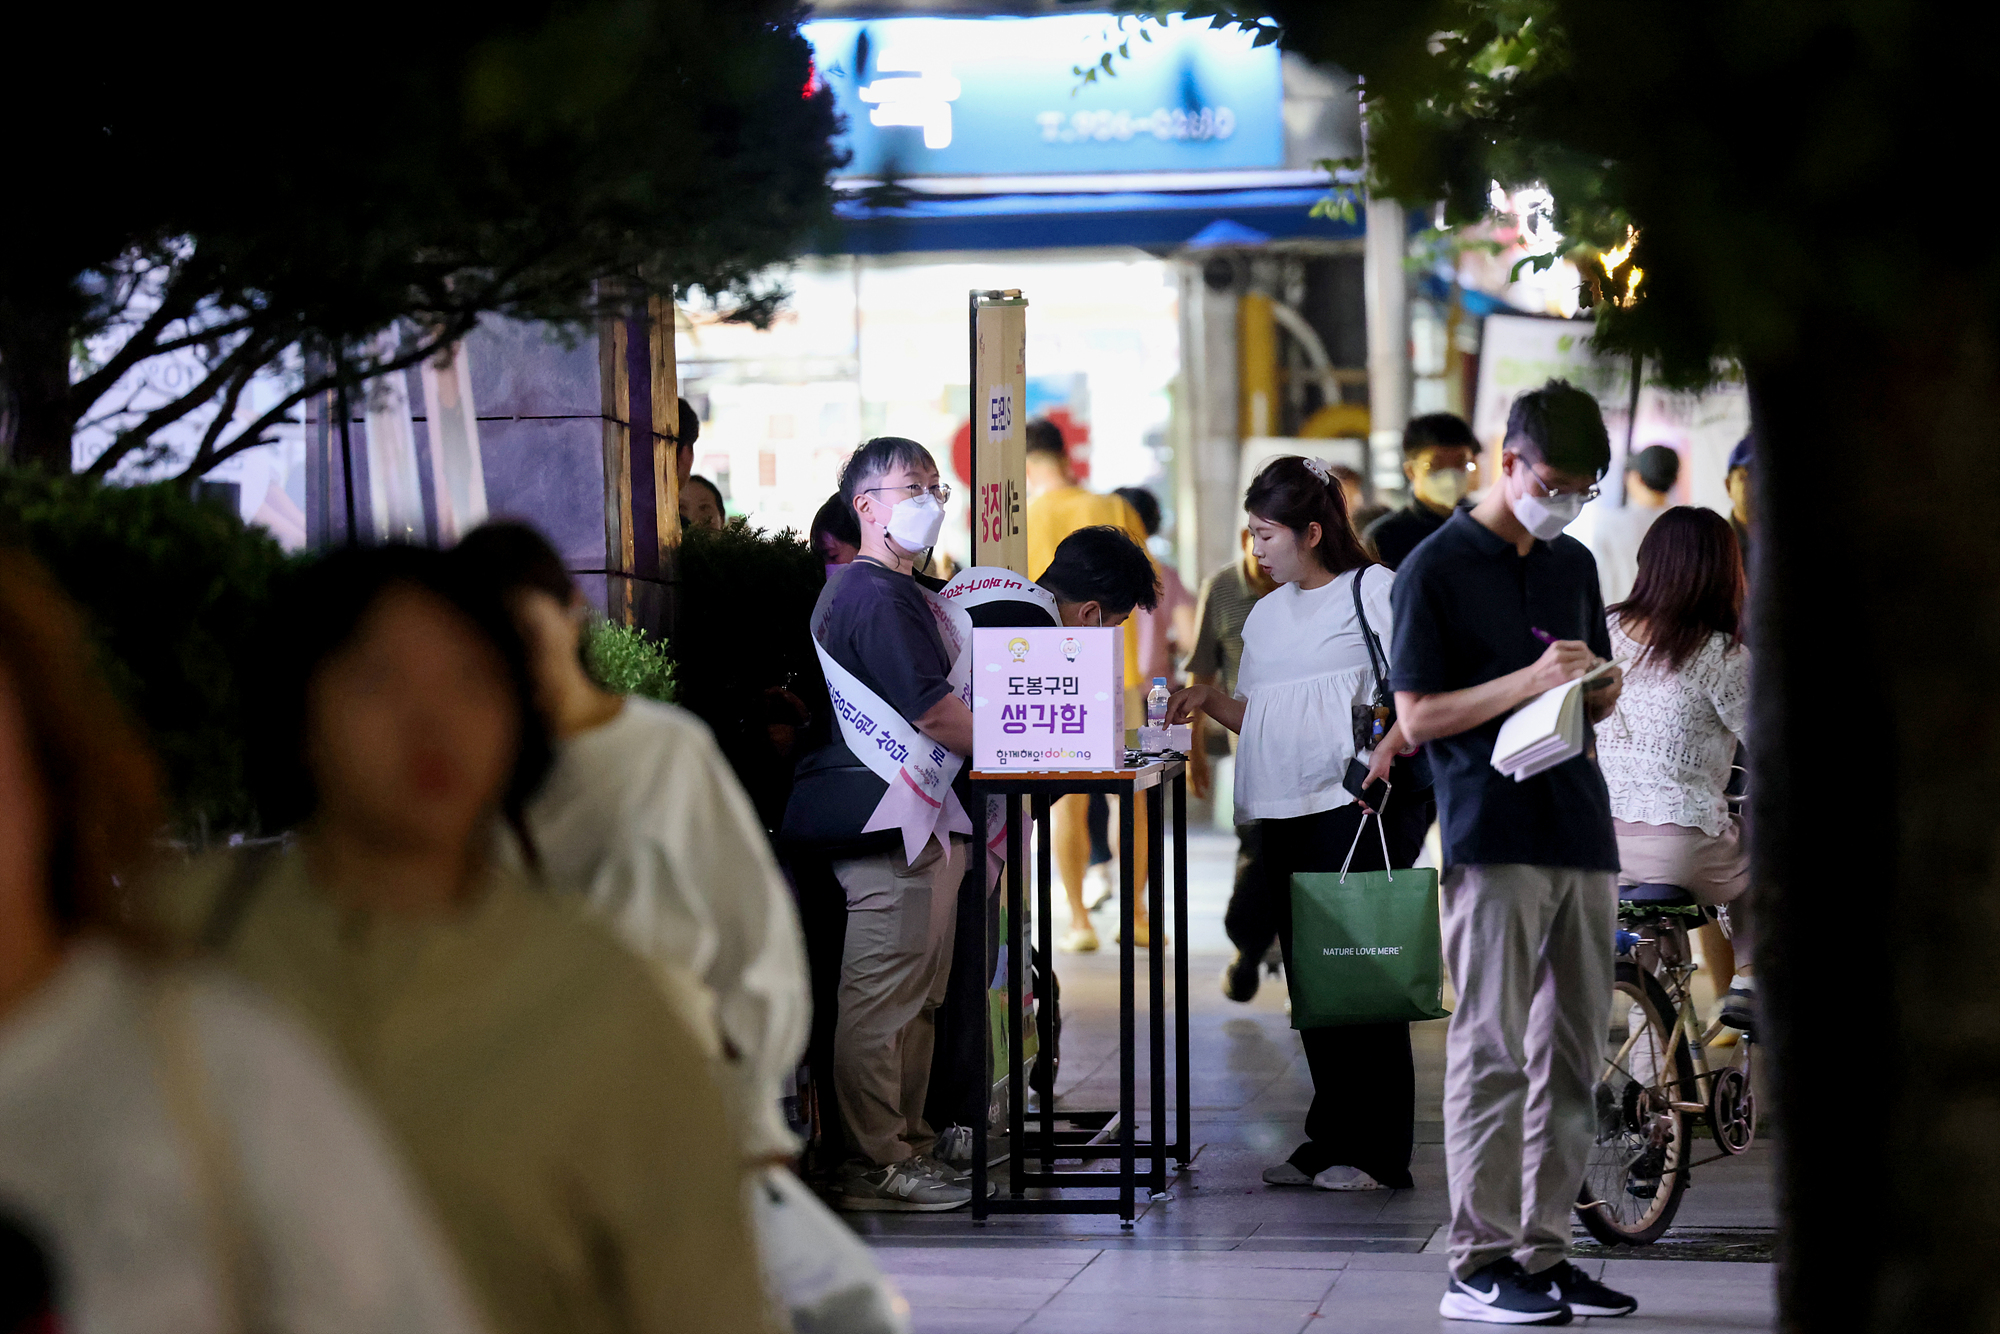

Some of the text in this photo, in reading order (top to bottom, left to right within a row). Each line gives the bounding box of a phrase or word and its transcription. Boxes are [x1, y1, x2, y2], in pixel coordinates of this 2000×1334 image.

[1008, 676, 1079, 695] 도봉구민
[1001, 703, 1088, 734] 생각함
[1044, 747, 1092, 761] dobong
[1323, 947, 1354, 956] NATURE
[1355, 947, 1376, 956] LOVE
